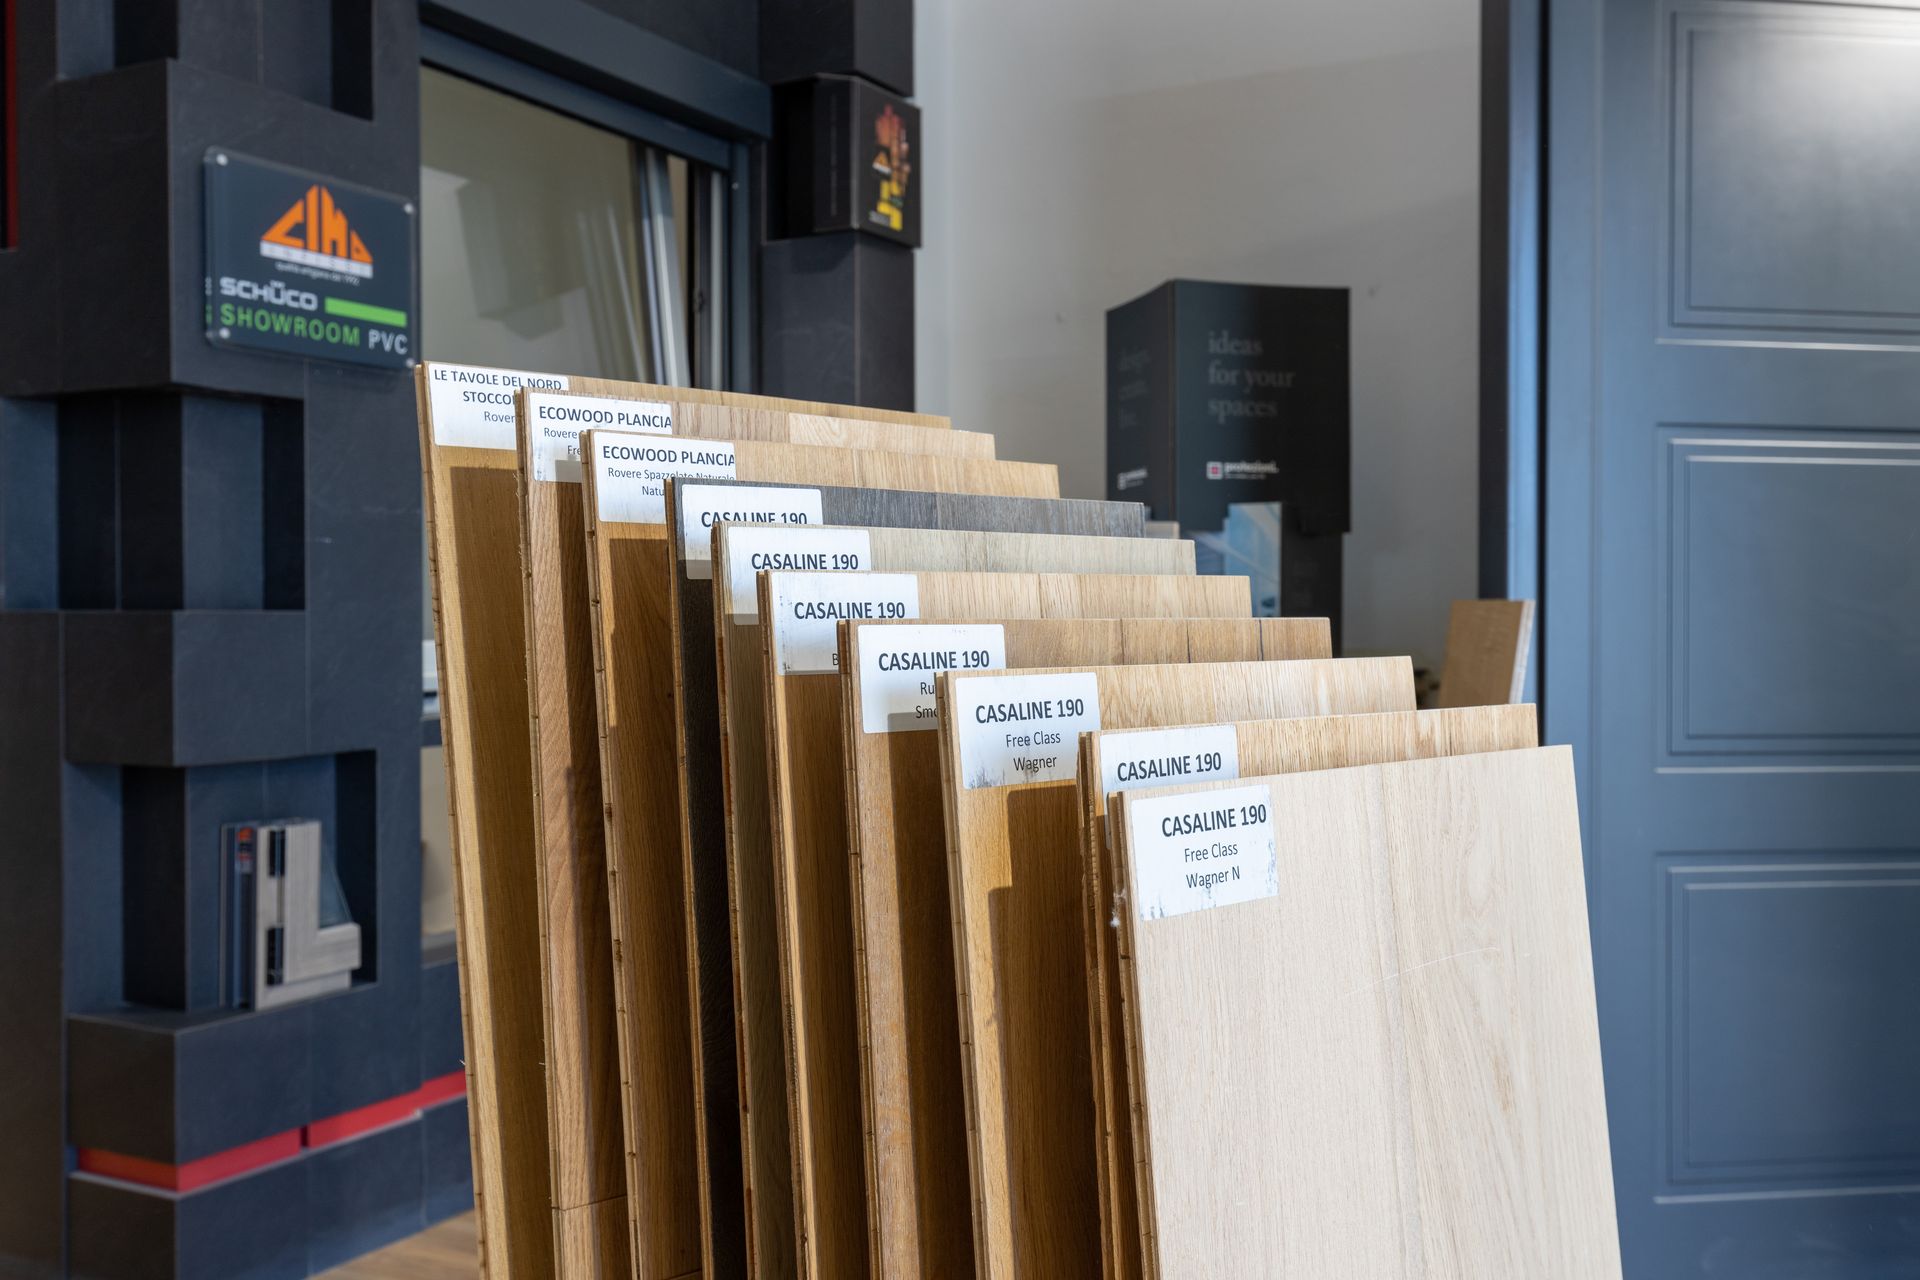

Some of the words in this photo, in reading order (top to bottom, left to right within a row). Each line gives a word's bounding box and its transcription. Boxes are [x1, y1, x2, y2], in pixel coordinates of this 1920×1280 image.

[219, 276, 318, 311] SCHÜCO
[220, 303, 360, 347] SHOWROOM
[368, 328, 408, 355] PVC
[1208, 329, 1263, 355] ideas
[434, 369, 448, 381] LE
[450, 370, 499, 385] TAVOLE
[502, 375, 523, 387] DEL
[527, 378, 562, 390] NORD
[1208, 359, 1239, 386] for
[1243, 370, 1296, 393] your
[463, 390, 515, 405] STOCCO
[484, 411, 515, 423] Rover
[539, 406, 613, 424] ECOWOOD
[617, 412, 672, 428] PLANCIA
[1208, 398, 1278, 424] spaces
[544, 427, 577, 439] Rovere
[567, 445, 580, 455] Fre
[603, 445, 677, 463] ECOWOOD
[681, 451, 735, 466] PLANCIA
[608, 467, 641, 479] Rovere
[642, 486, 664, 496] Natu
[780, 512, 807, 524] 190
[751, 553, 827, 570] CASALINE
[831, 554, 858, 569] 190
[794, 602, 873, 619] CASALINE
[877, 602, 905, 619] 190
[878, 651, 957, 671] CASALINE
[962, 650, 990, 668] 190
[976, 701, 1052, 723] CASALINE
[1057, 698, 1084, 718] 190
[1006, 734, 1031, 747] Free
[1033, 731, 1061, 745] Class
[1013, 756, 1057, 773] Wagner
[1117, 755, 1191, 782] CASALINE
[1195, 752, 1222, 773] 190
[1162, 808, 1236, 837] CASALINE
[1240, 804, 1267, 826] 190
[1184, 848, 1209, 863] Free
[1211, 842, 1238, 859] Class
[1186, 870, 1229, 889] Wagner
[1232, 866, 1241, 880] N
